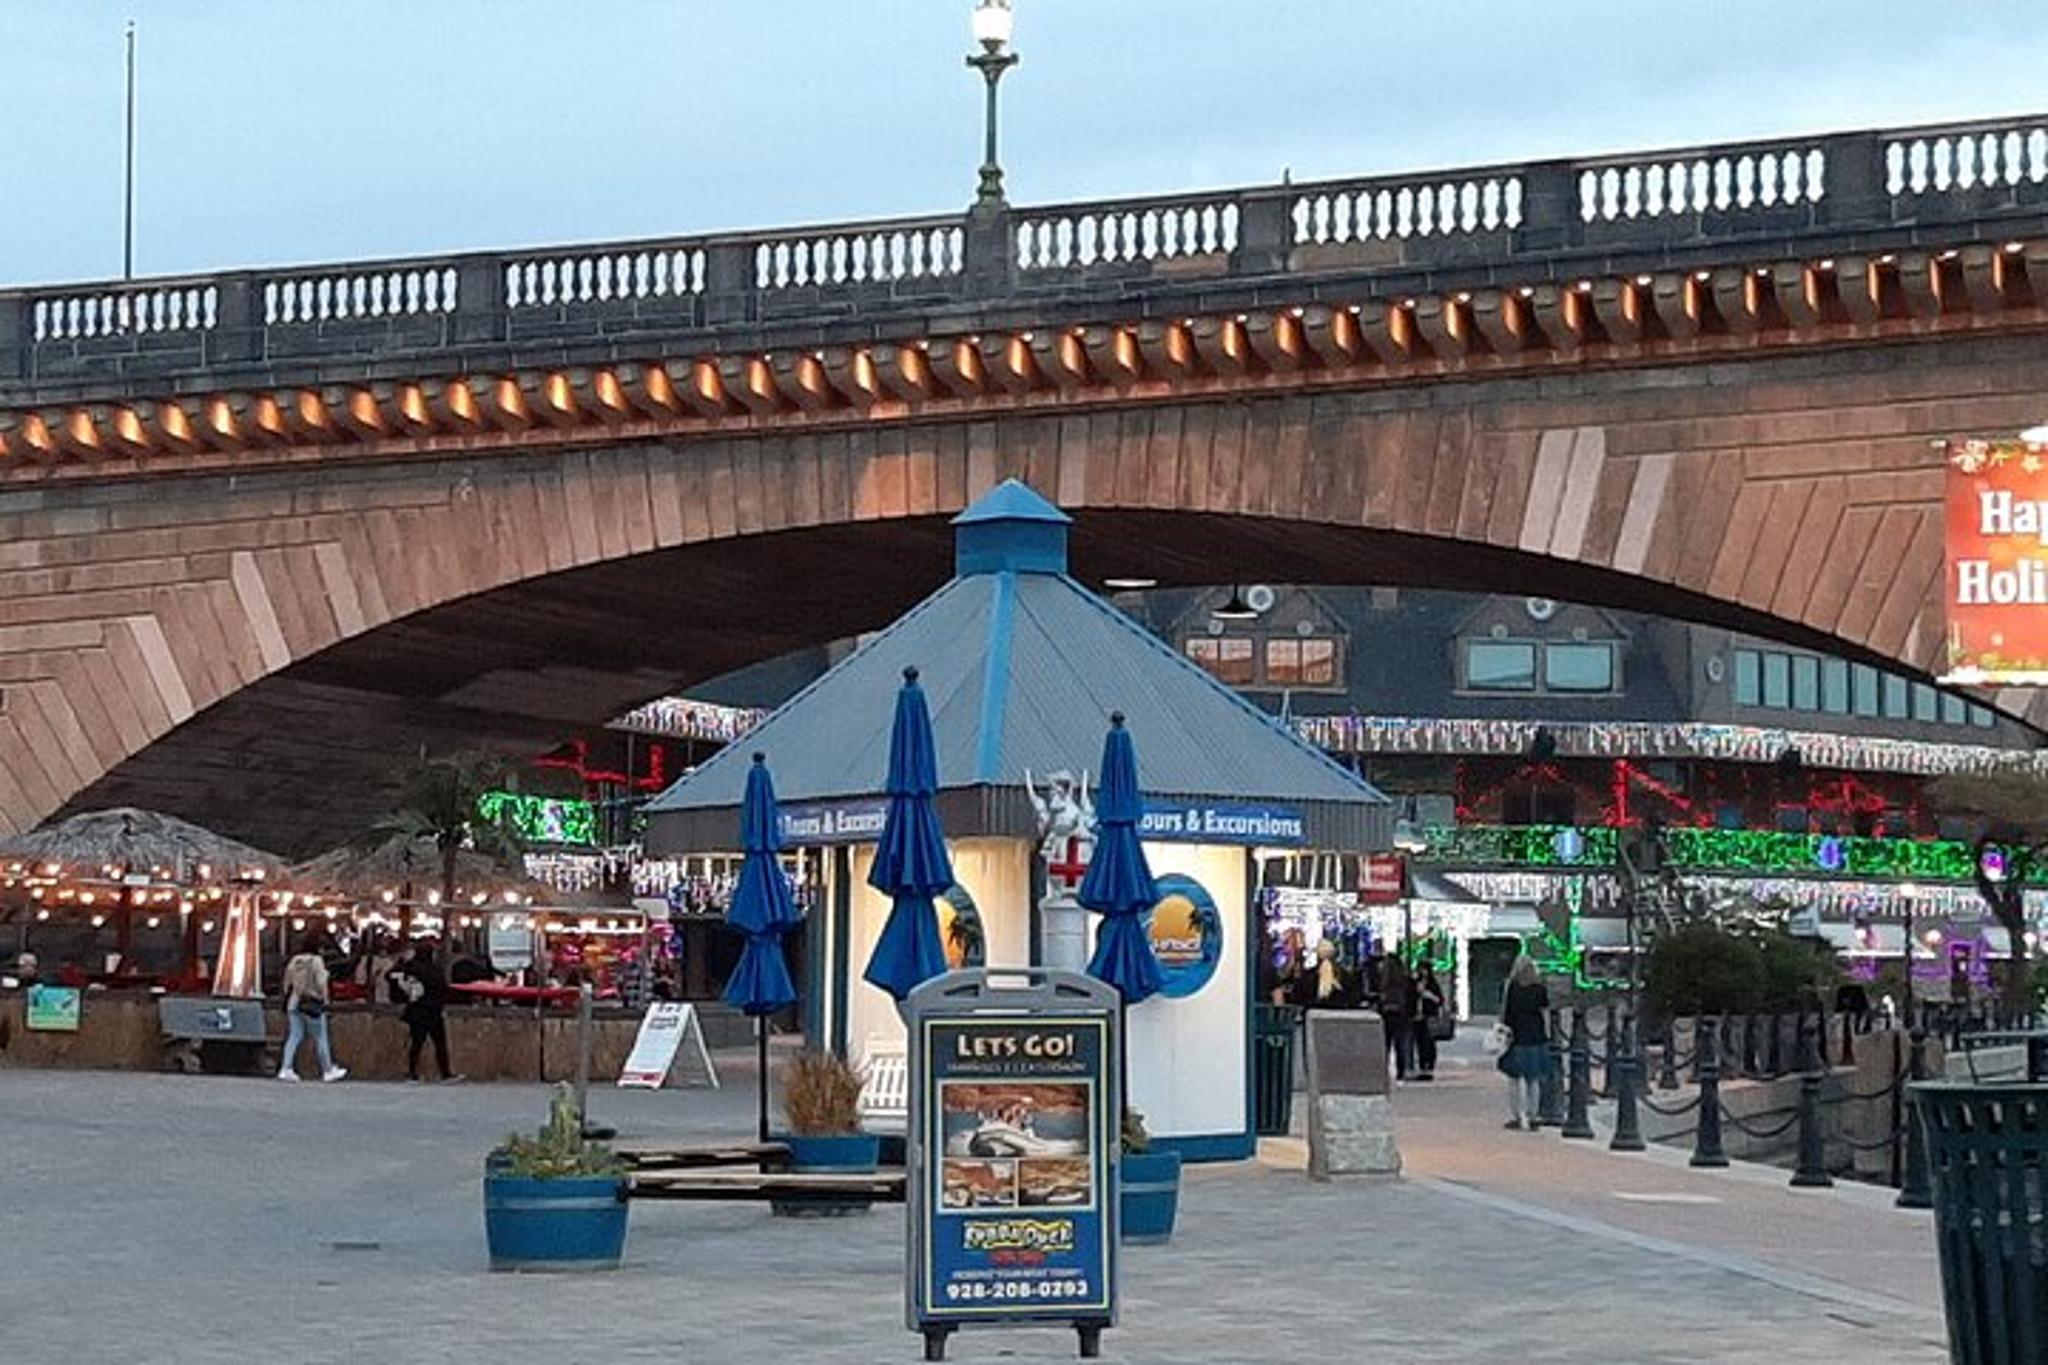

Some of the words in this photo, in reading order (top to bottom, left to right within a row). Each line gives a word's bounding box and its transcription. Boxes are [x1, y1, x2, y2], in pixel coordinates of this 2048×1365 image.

[1957, 558, 2047, 604] Holi
[1140, 813, 1182, 831] ours
[1186, 810, 1199, 832] &
[1204, 811, 1301, 836] Excursions
[1024, 1034, 1074, 1056] GO!
